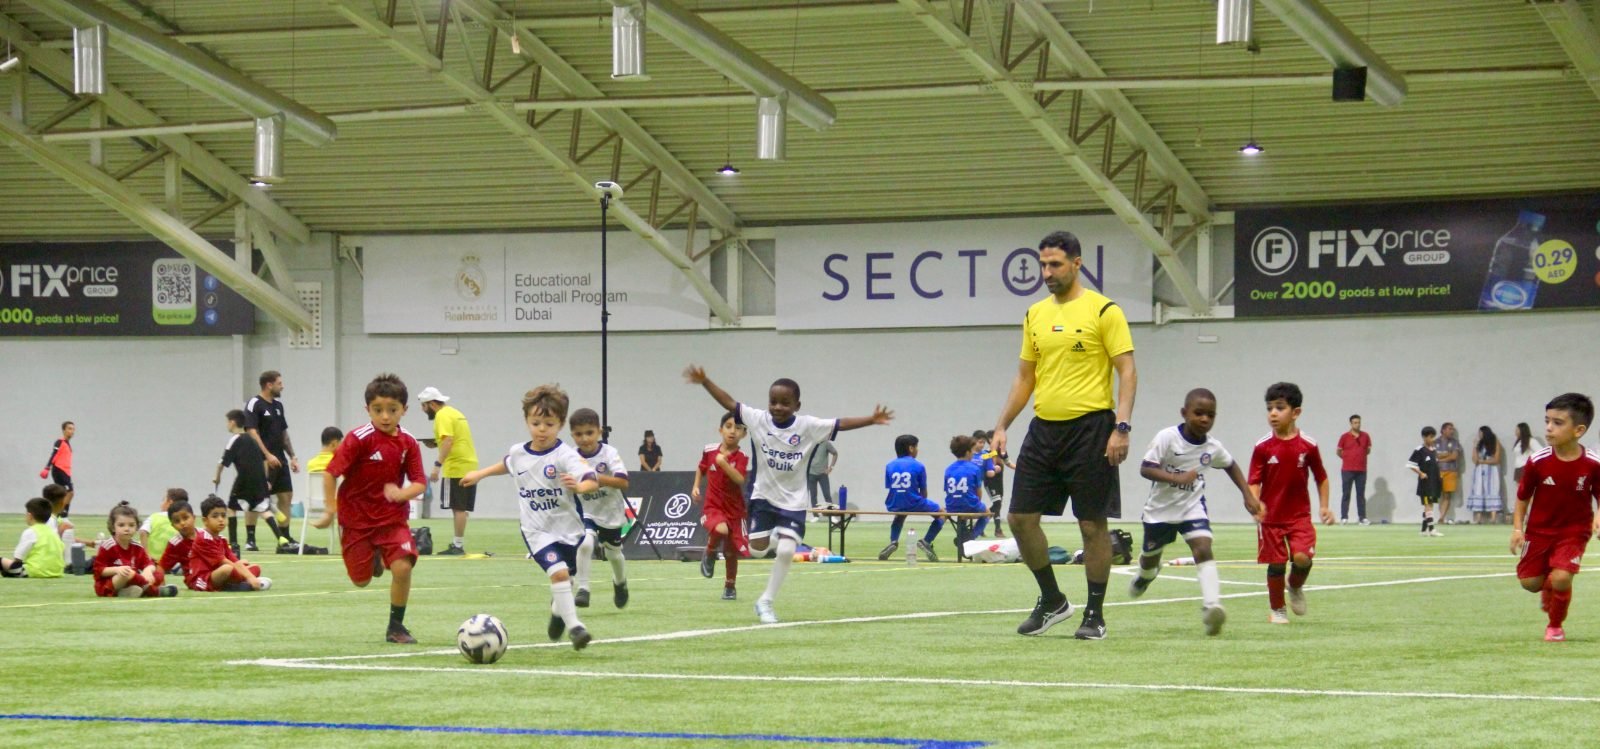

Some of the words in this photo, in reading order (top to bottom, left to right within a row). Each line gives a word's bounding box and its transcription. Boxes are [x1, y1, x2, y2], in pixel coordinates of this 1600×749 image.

[1408, 252, 1446, 263] GROUP
[1535, 248, 1573, 269] 0.29
[514, 274, 591, 287] Educational
[1547, 270, 1566, 279] AED
[1250, 288, 1278, 300] Over
[1281, 281, 1336, 300] 2000
[1339, 286, 1375, 300] goods
[1378, 287, 1390, 297] at
[1393, 285, 1414, 296] low
[1416, 284, 1451, 298] price!
[514, 290, 567, 304] Football
[572, 290, 628, 306] Progam
[0, 308, 33, 324] 000
[35, 314, 63, 325] goods
[65, 314, 74, 323] at
[76, 314, 92, 323] low
[94, 314, 119, 325] price!
[514, 308, 552, 321] Dubai
[761, 444, 803, 460] Careem
[767, 458, 794, 471] Quik
[891, 472, 912, 489] 23
[947, 477, 968, 494] 34
[530, 499, 560, 511] Quik
[642, 527, 696, 539] DUBAI
